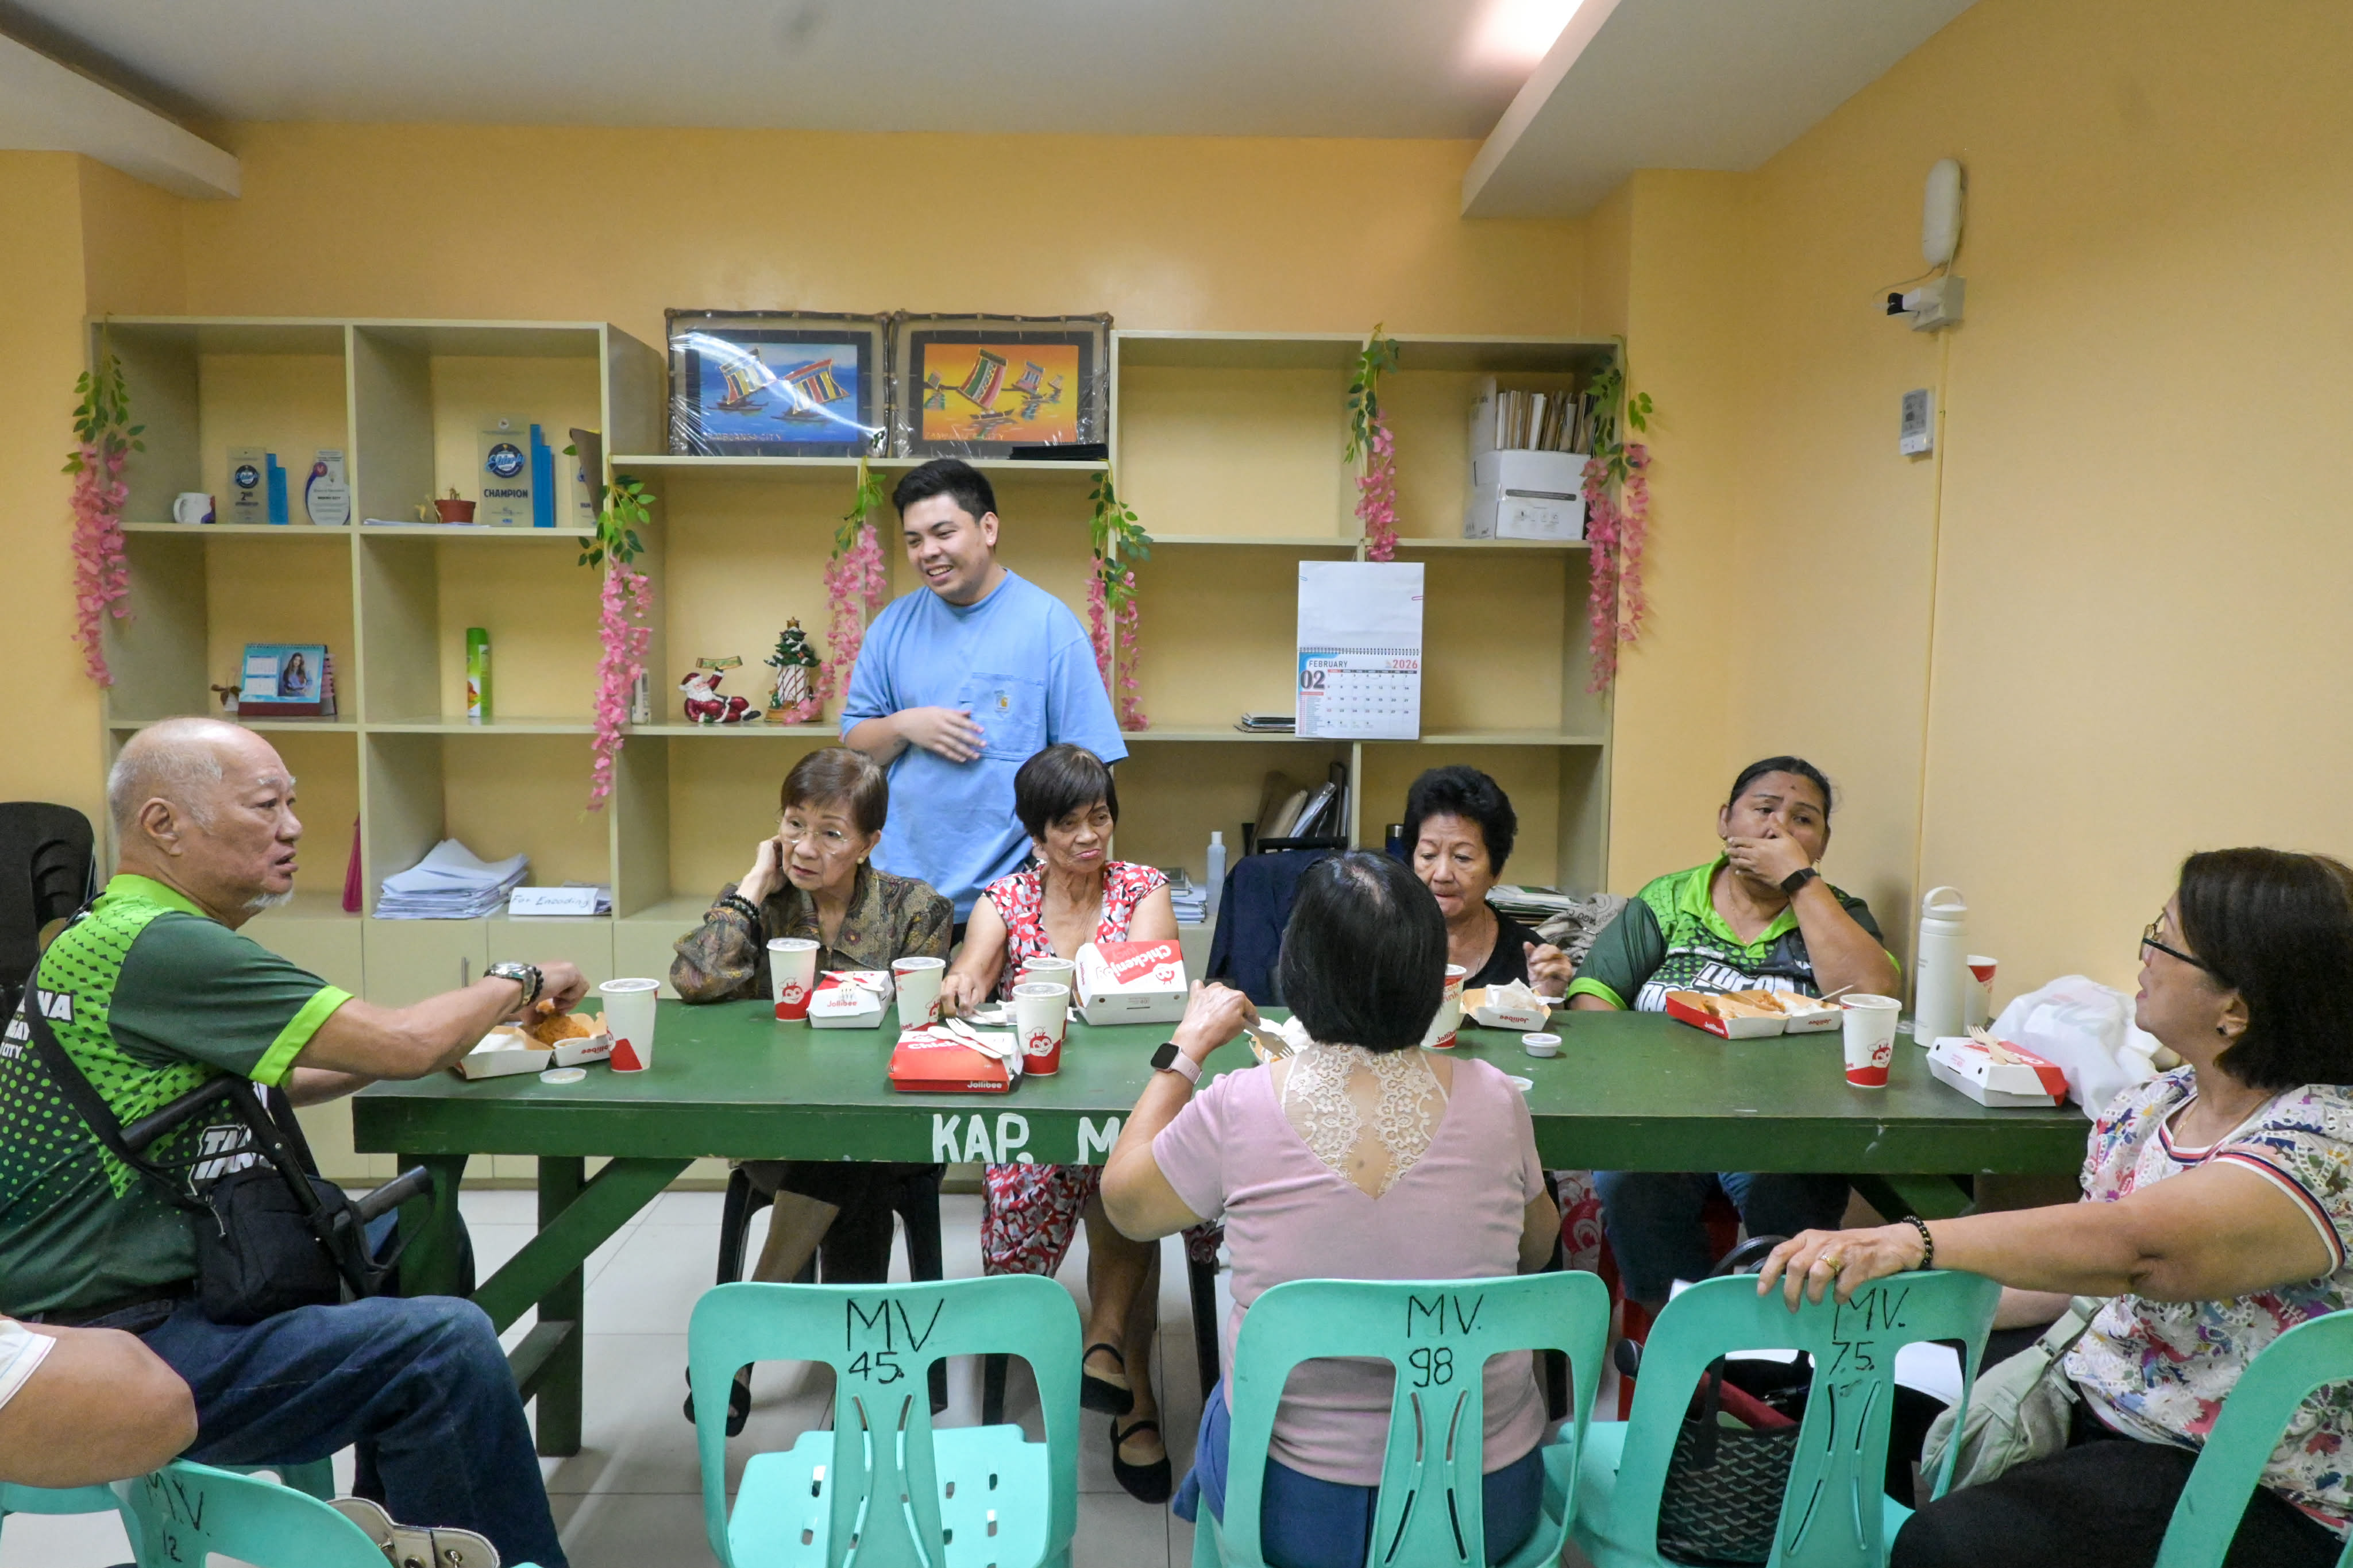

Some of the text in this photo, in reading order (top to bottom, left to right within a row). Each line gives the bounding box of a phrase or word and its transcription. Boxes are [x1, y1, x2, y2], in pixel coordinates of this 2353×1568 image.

[484, 489, 528, 498] CHAMPION
[1393, 659, 1418, 669] 2026
[1300, 670, 1325, 690] 02
[512, 895, 589, 908] For Encoding
[1096, 945, 1171, 979] Chickenjoy
[1499, 1015, 1529, 1024] Jollibee
[581, 1045, 610, 1055] ollibee
[932, 1113, 1034, 1163] KAP.
[847, 1297, 944, 1352] MV
[1409, 1347, 1453, 1388] 98
[163, 1530, 183, 1562] 12
